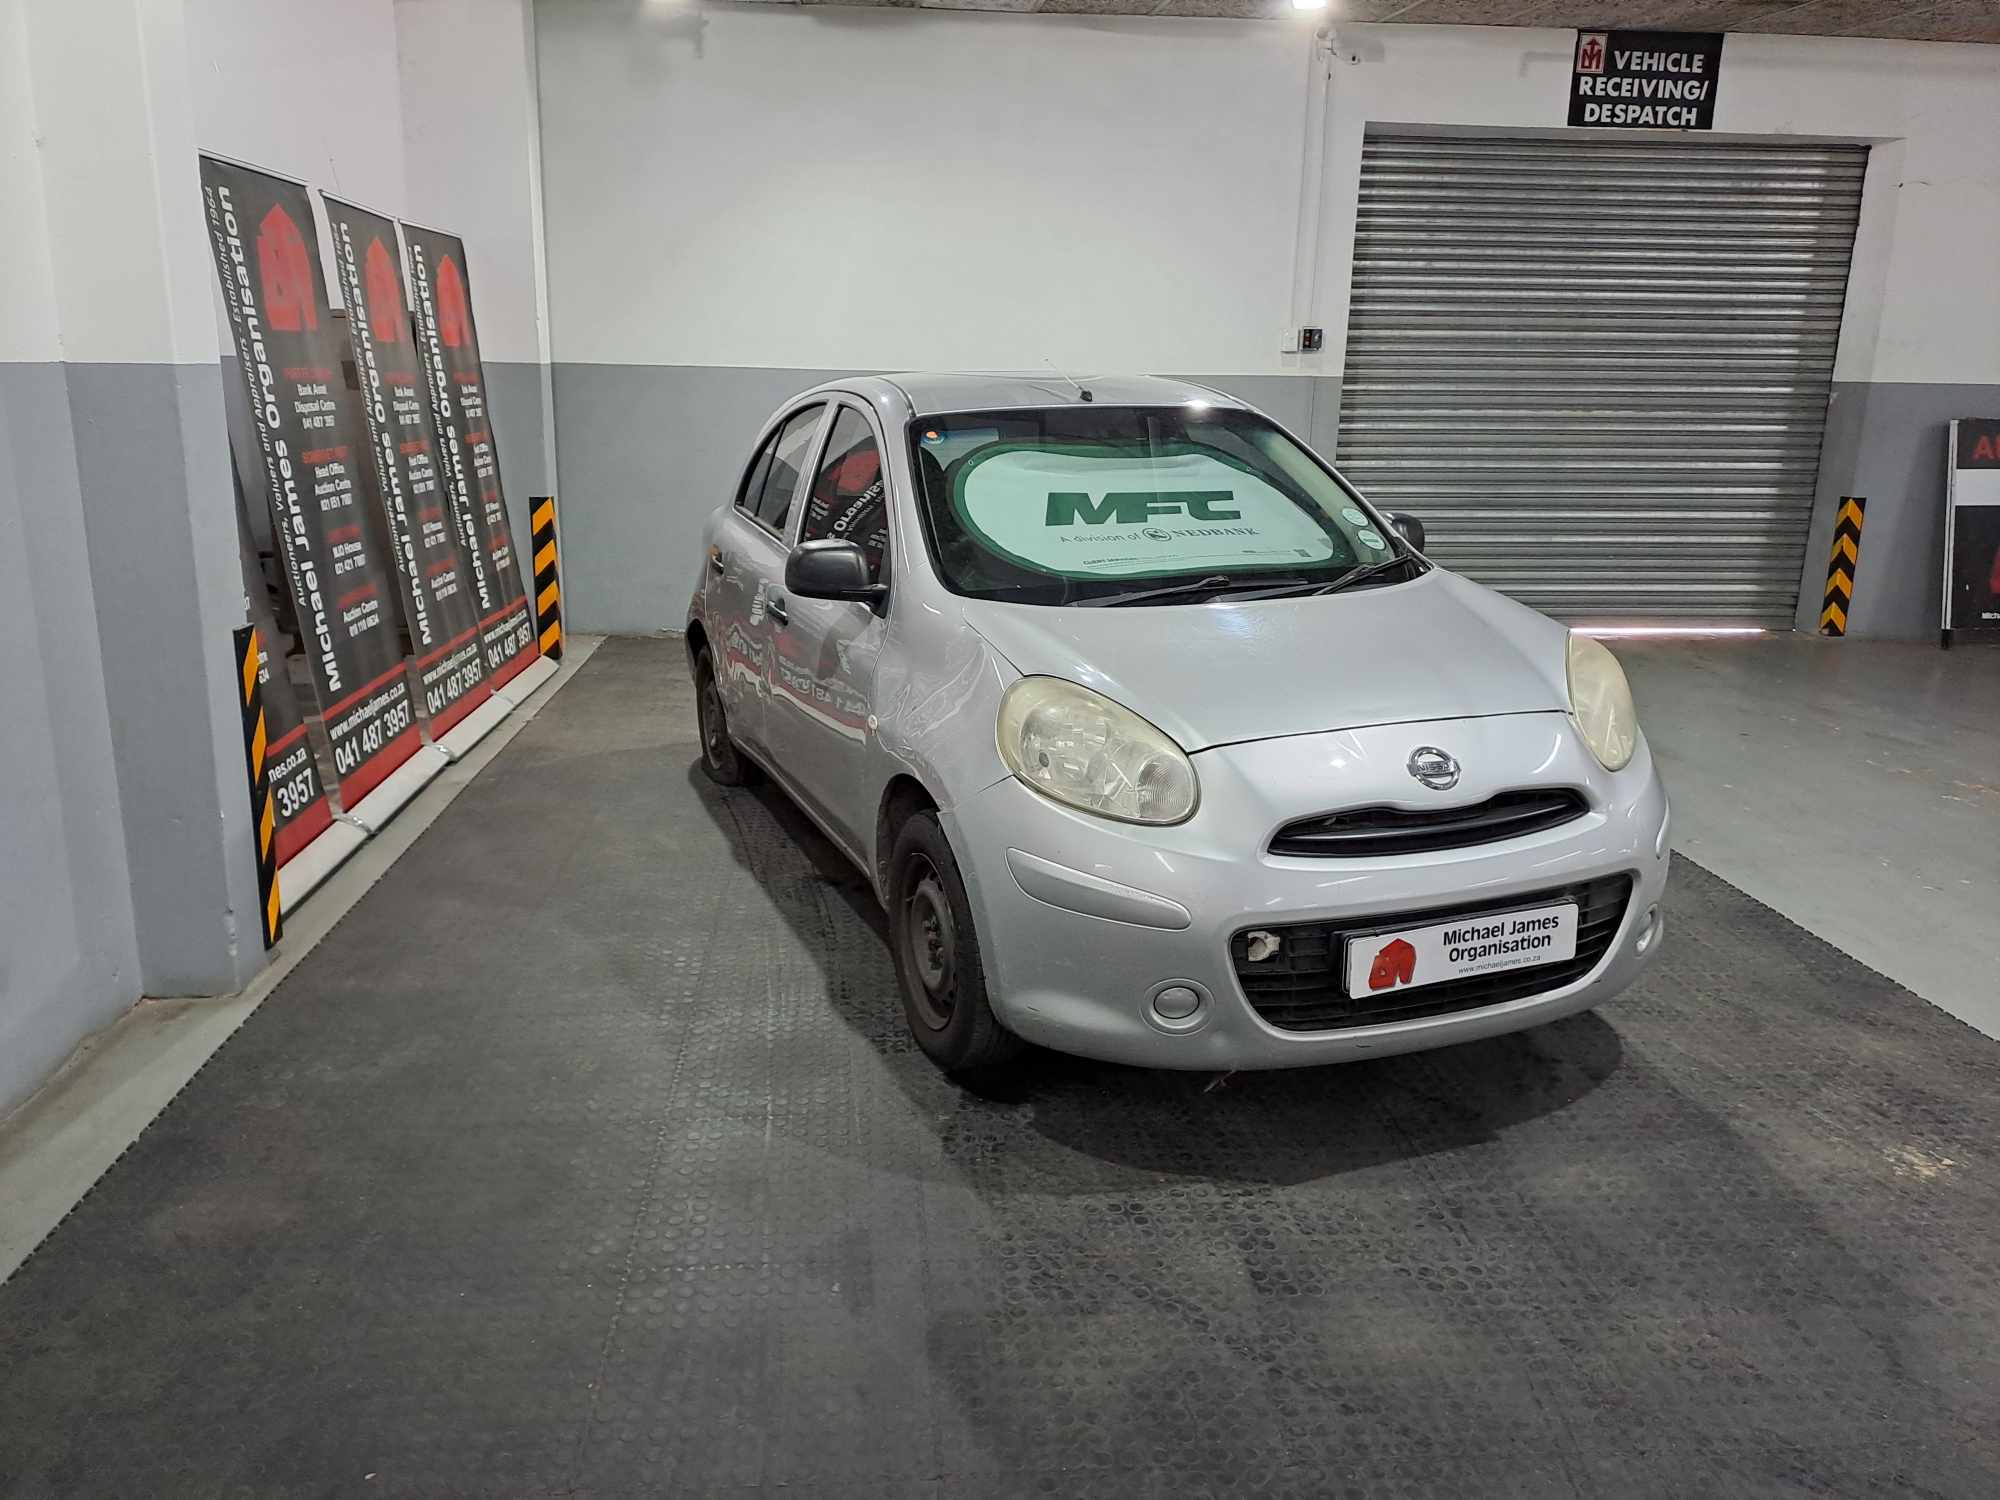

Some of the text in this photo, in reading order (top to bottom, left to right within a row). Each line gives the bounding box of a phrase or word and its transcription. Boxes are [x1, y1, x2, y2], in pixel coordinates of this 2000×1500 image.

[1578, 76, 1710, 101] RECEIVING/
[1613, 50, 1705, 74] VEHICLE
[1583, 103, 1698, 126] DESPATCH
[204, 185, 220, 226] 1964
[213, 230, 242, 322] Established
[340, 221, 386, 424] Organisation
[413, 244, 451, 418] Organisation
[240, 338, 264, 420] Appraisers
[218, 186, 342, 692] Michael James Organisation
[257, 421, 271, 452] and
[266, 456, 285, 511] Valuers
[381, 431, 408, 527] James
[446, 425, 470, 507] James
[1045, 490, 1241, 526] MFC
[1060, 526, 1260, 544] A division of NEDBANK
[281, 516, 307, 607] Auctioneers,
[462, 513, 491, 609] Michael
[400, 534, 432, 646] Michael
[487, 643, 505, 669] 041
[504, 633, 517, 657] 487
[426, 657, 482, 715] 041 487 3957
[334, 699, 411, 776] 041 487 3957
[277, 767, 315, 817] 3957
[1443, 916, 1559, 946] Michael James
[1449, 934, 1551, 962] Organisation
